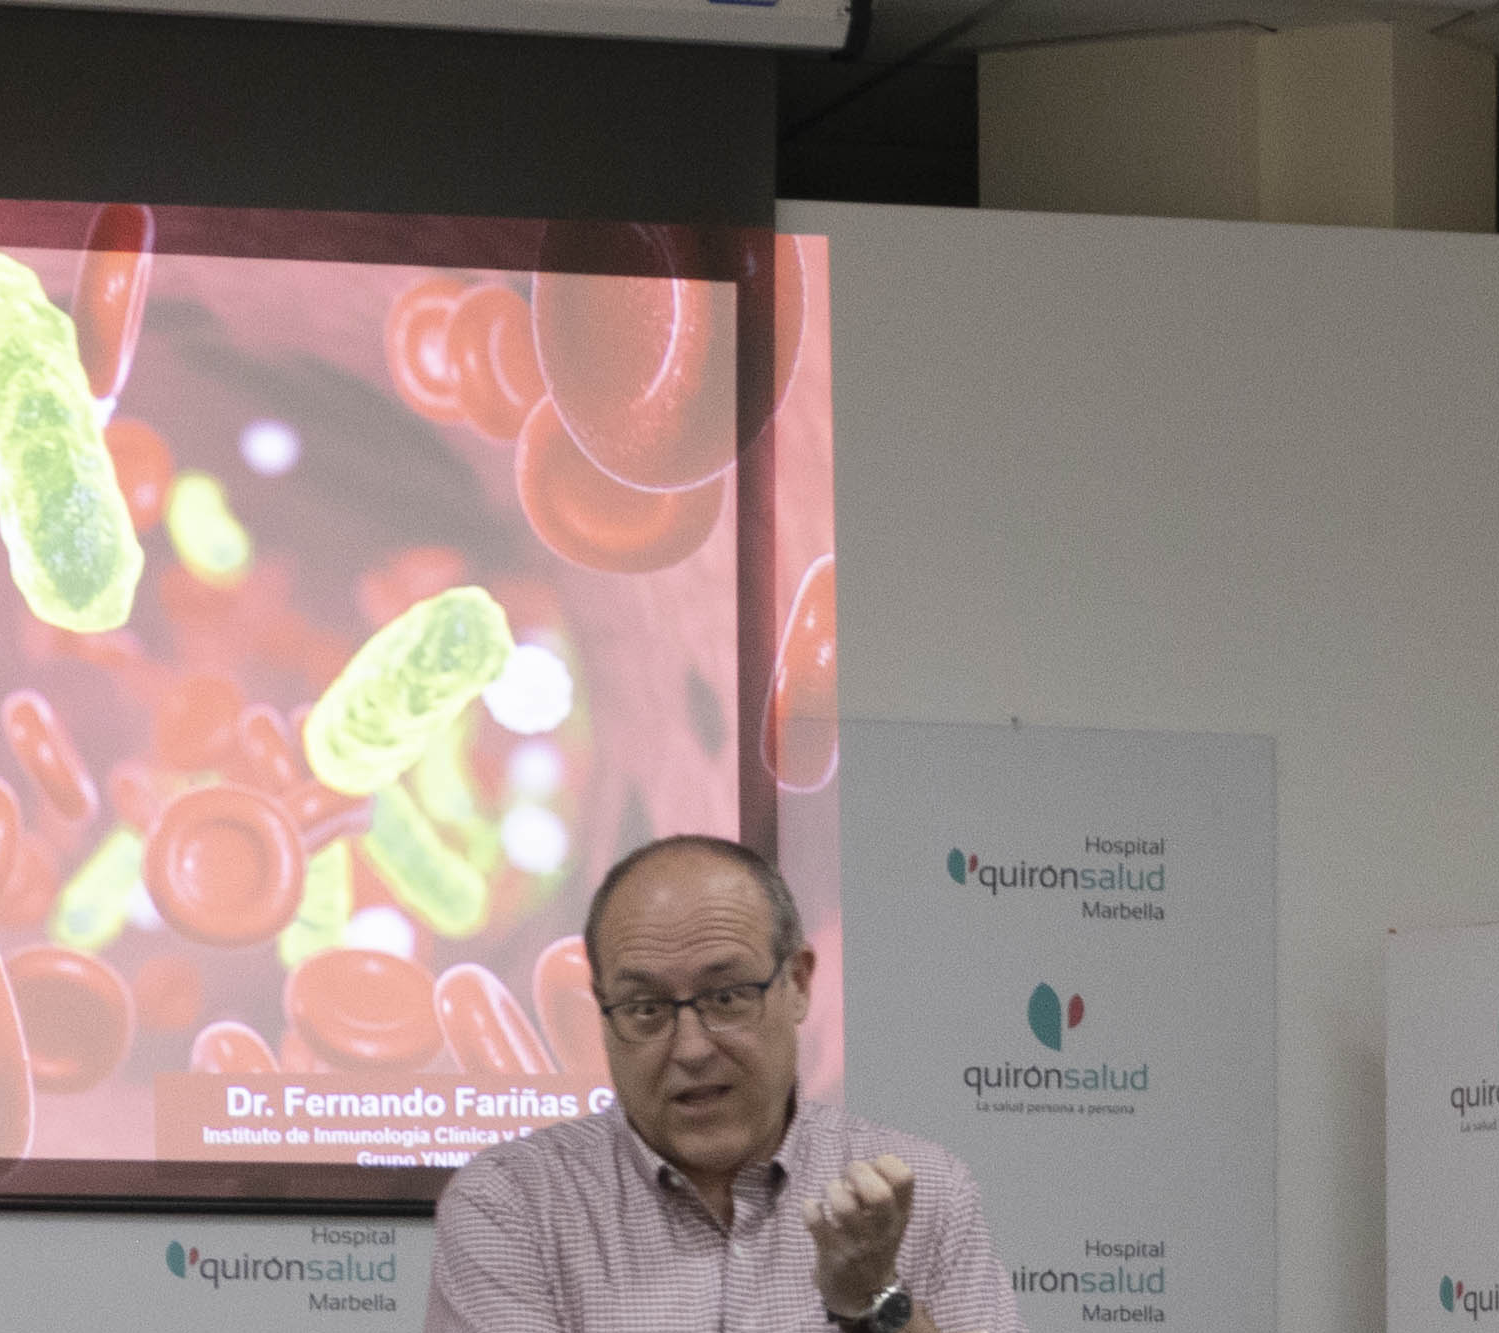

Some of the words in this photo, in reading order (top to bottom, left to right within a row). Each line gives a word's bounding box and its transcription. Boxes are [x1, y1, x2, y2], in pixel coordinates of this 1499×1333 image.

[1084, 836, 1165, 859] Hospital
[1082, 901, 1165, 921] Marbella
[226, 1086, 274, 1117] Dr.
[283, 1086, 446, 1117] Fernando
[454, 1086, 579, 1117] Fariñas
[202, 1126, 282, 1145] Instituto
[285, 1126, 310, 1145] de
[310, 1227, 397, 1248] Hospital
[1084, 1240, 1165, 1261] Hospital
[308, 1292, 397, 1312] Marbella
[1082, 1303, 1165, 1323] Marbella
